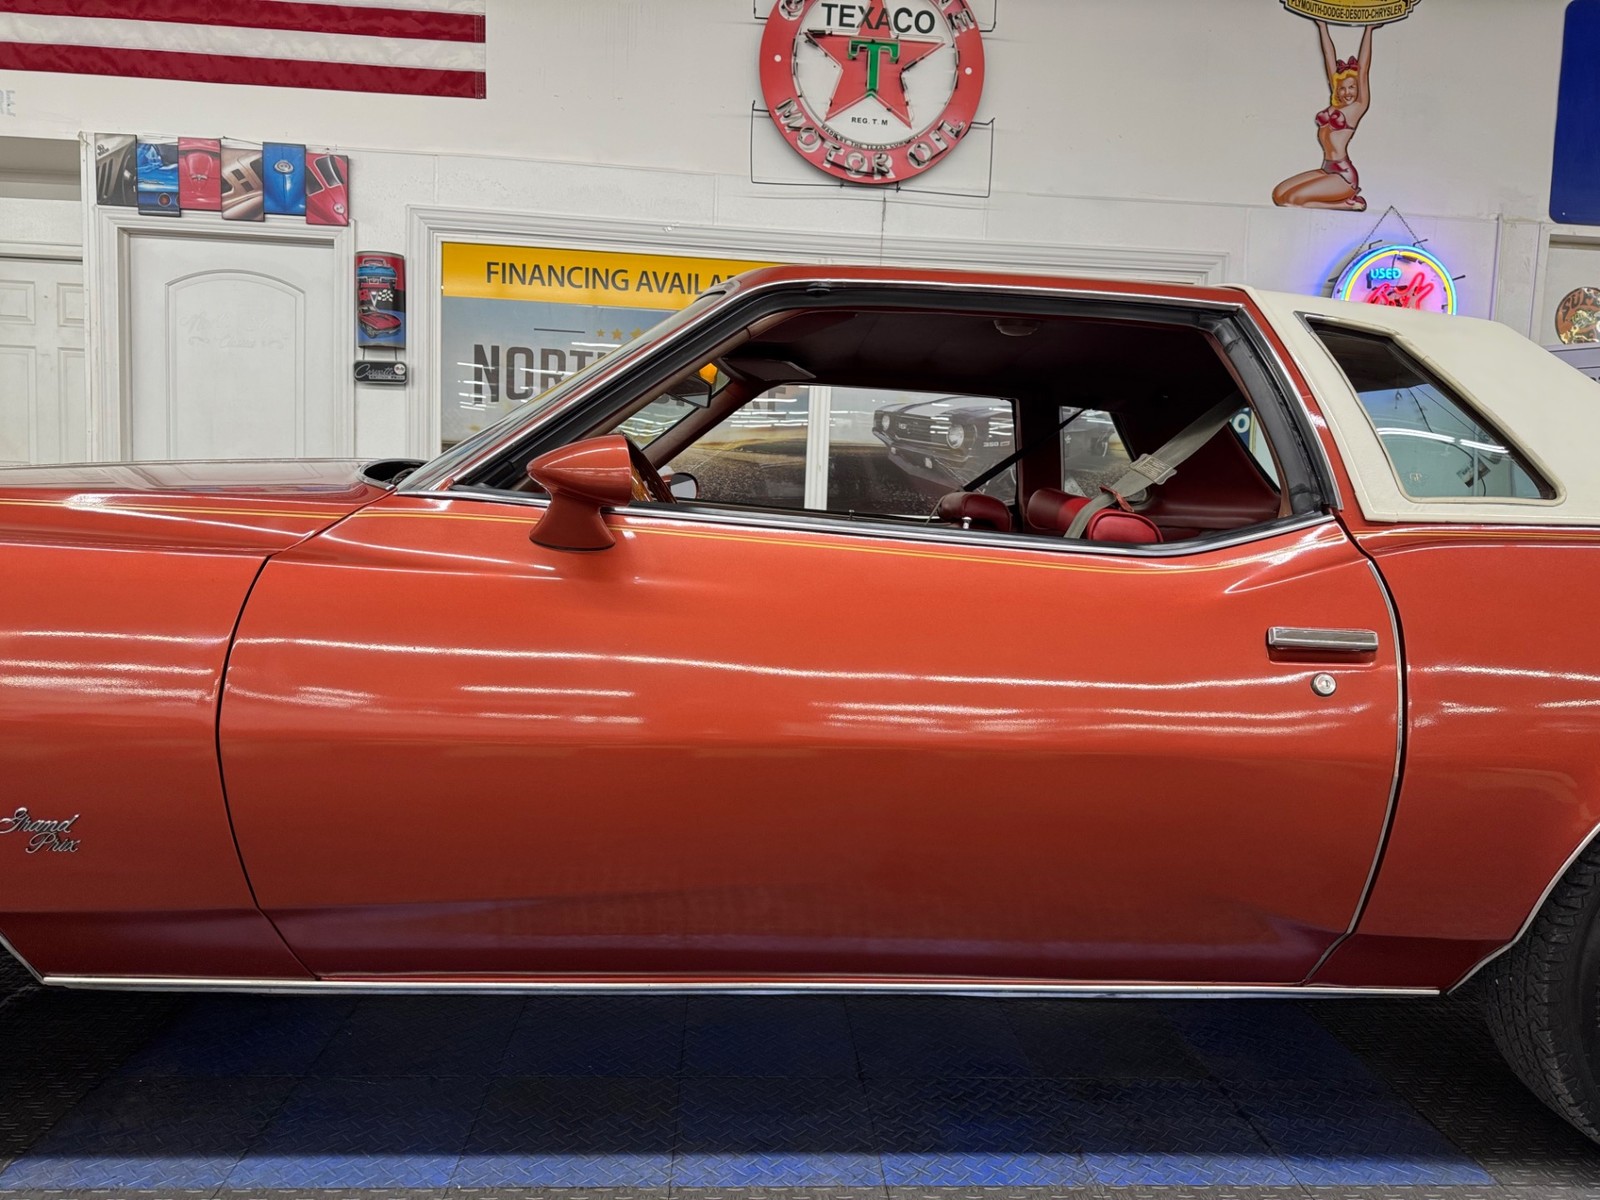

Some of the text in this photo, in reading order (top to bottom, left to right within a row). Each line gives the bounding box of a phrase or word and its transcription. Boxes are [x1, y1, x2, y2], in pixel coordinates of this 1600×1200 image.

[821, 3, 936, 33] TEXACO
[848, 38, 900, 97] T
[775, 98, 896, 180] MOTOR
[907, 119, 966, 169] OIL
[486, 261, 736, 295] FINANCING AVAILA
[1370, 267, 1402, 280] USED
[474, 344, 607, 405] NORT
[0, 806, 80, 834] Grand
[25, 831, 81, 854] Prix
